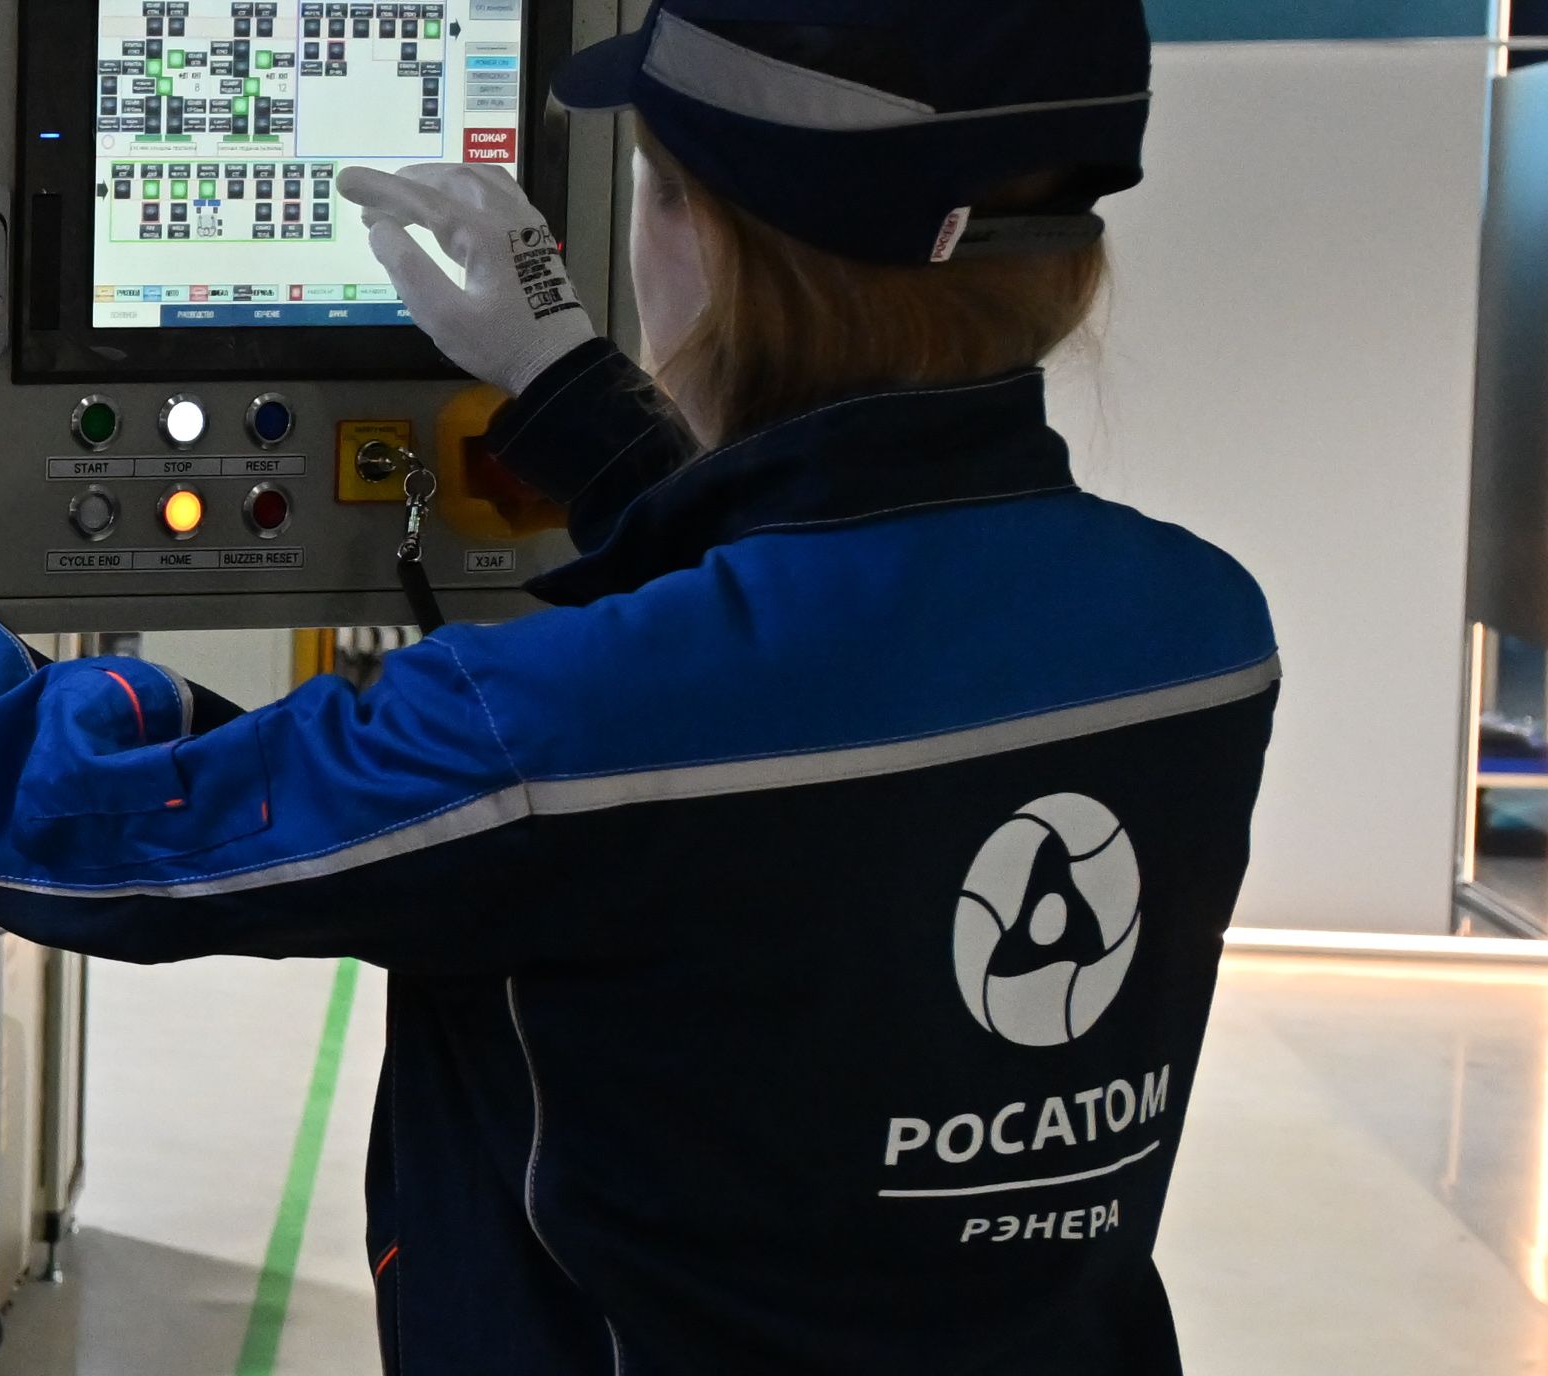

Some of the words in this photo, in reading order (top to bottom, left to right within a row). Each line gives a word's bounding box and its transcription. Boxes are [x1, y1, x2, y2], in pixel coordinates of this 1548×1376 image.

[470, 133, 508, 143] ПОЖАР
[468, 149, 509, 159] ТУШИТЬ
[74, 462, 109, 474] START
[163, 462, 193, 473] STOP
[245, 460, 281, 472] RESET
[59, 555, 95, 567] CYCLE
[98, 555, 121, 566] END
[160, 554, 192, 565] HOME
[223, 553, 263, 564] BUZZER
[267, 552, 299, 564] RESET
[475, 556, 505, 568] X3AF
[883, 1064, 1171, 1167] РОСАТОМ
[960, 1199, 1121, 1243] РЭНЕРА
